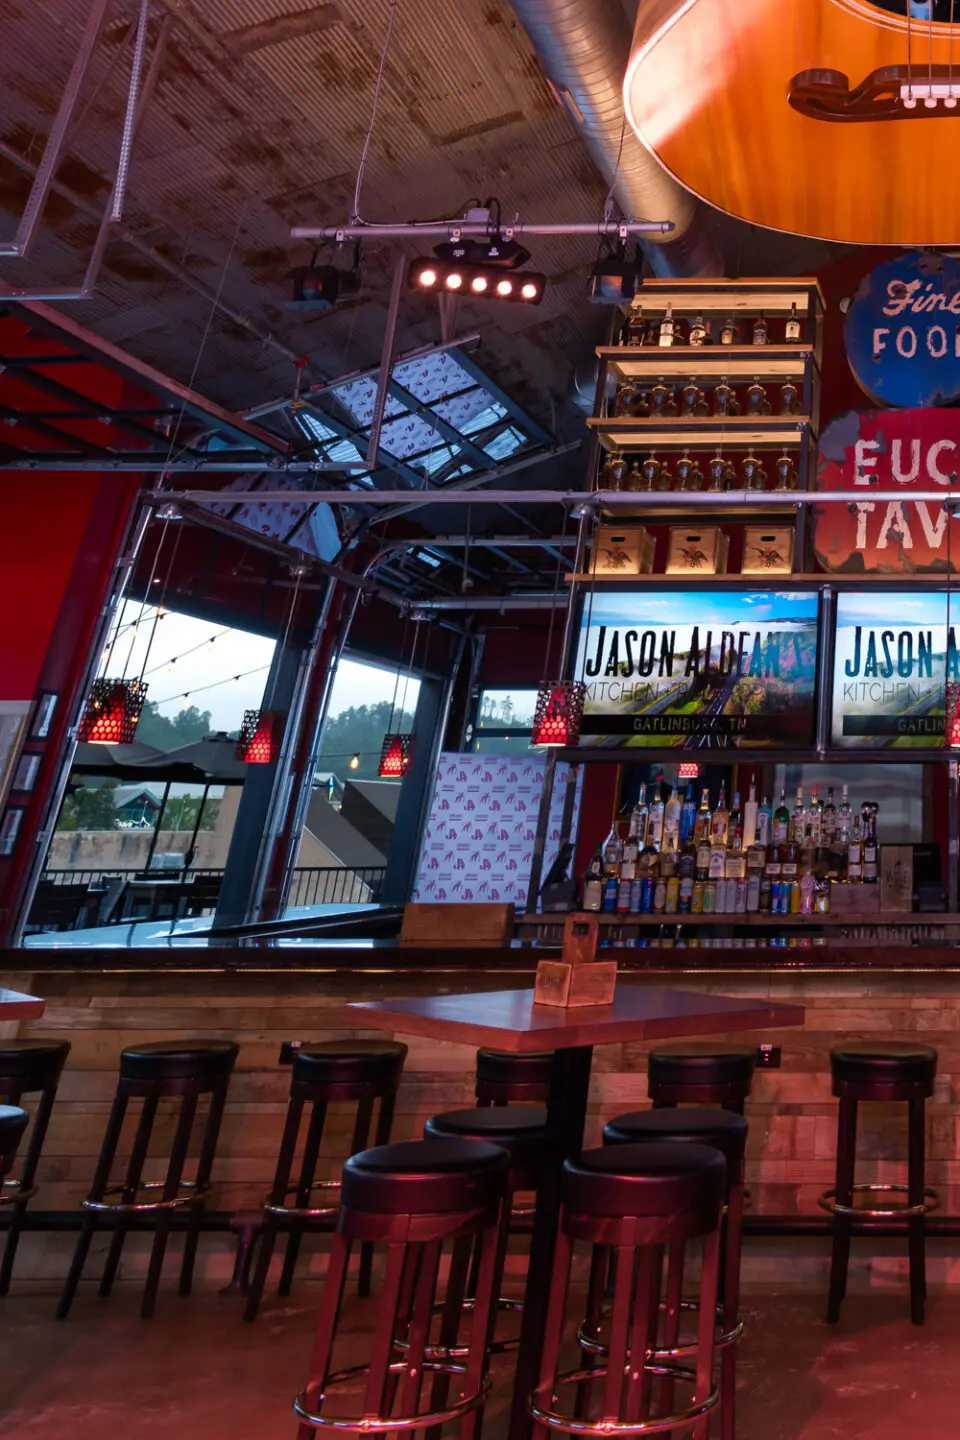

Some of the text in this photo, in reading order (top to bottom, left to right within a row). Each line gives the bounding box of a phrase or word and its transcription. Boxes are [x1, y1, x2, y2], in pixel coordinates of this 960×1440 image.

[585, 625, 676, 678] JASON
[844, 626, 933, 679] JASON
[843, 682, 921, 703] KITCHEN
